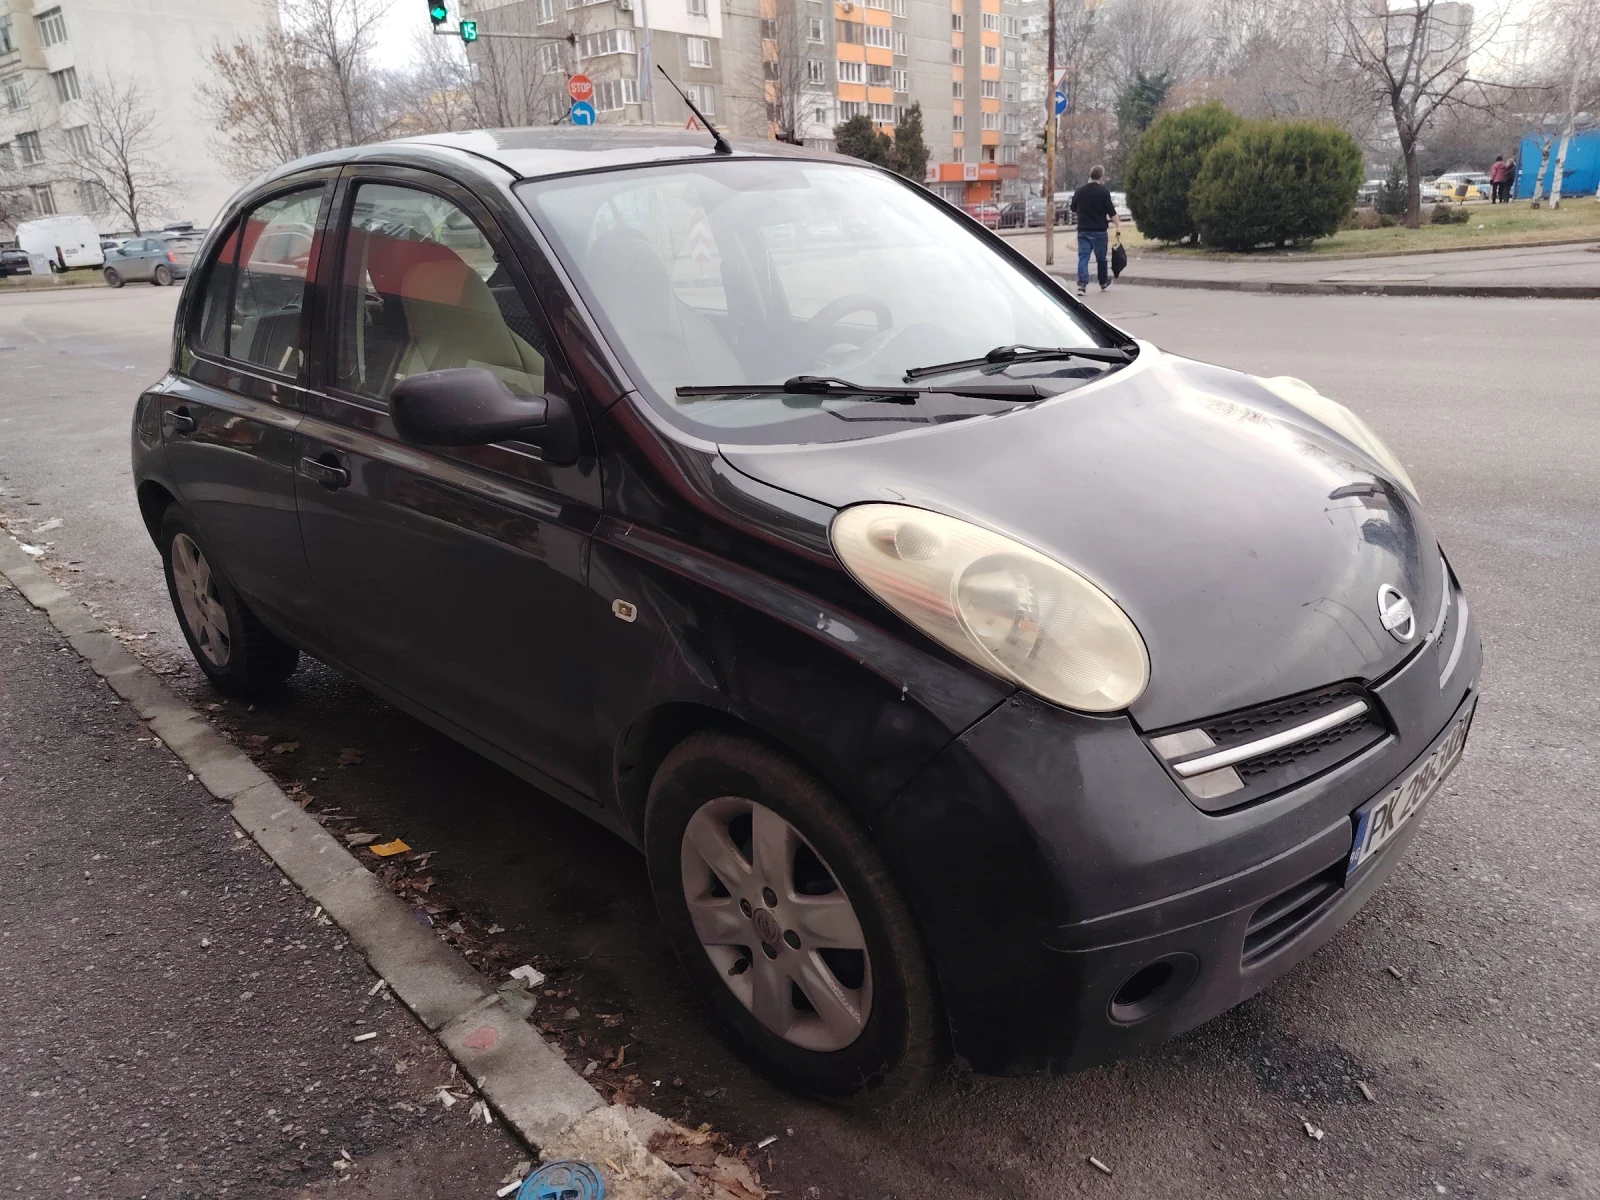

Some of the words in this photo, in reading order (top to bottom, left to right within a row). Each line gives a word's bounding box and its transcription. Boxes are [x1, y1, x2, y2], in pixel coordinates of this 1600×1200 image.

[464, 23, 477, 40] 15
[570, 82, 592, 93] STOP
[1365, 786, 1404, 853] PK
